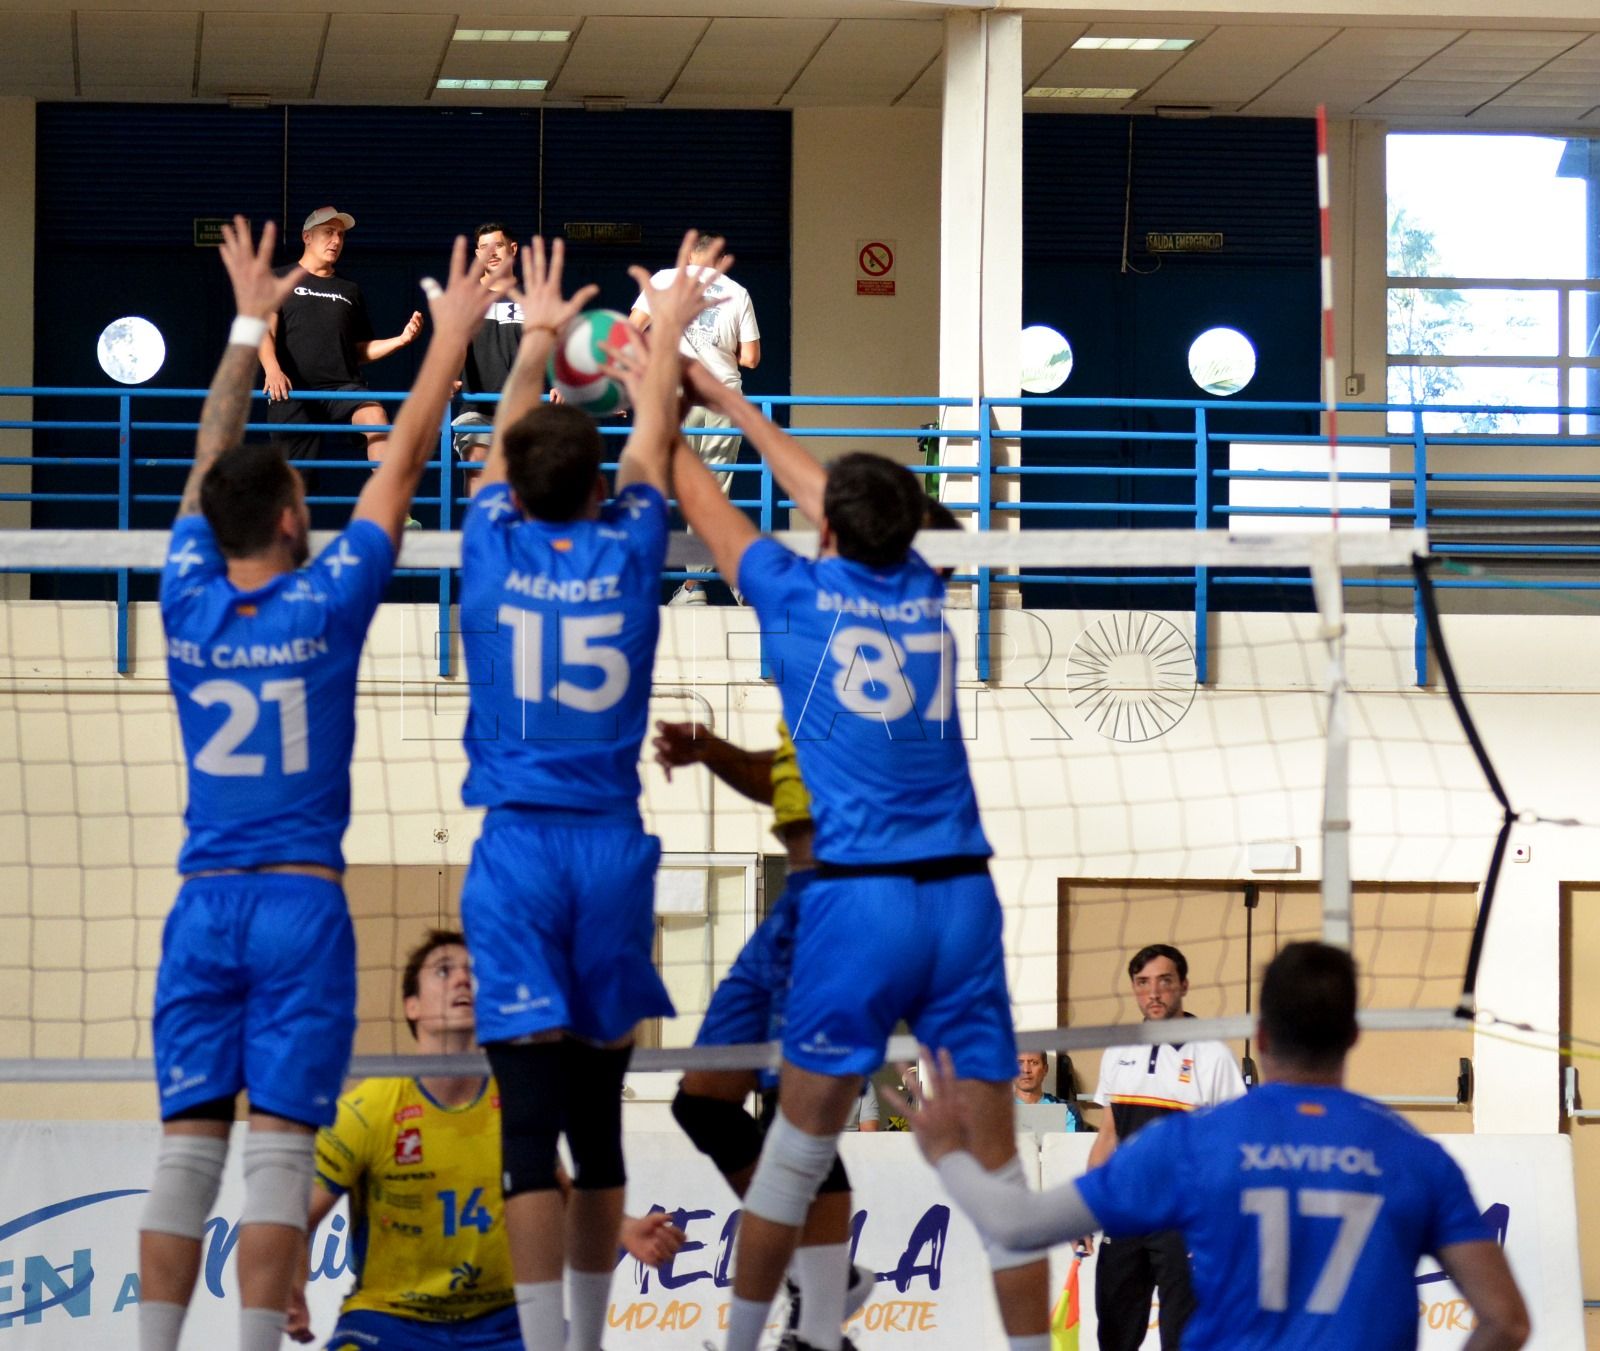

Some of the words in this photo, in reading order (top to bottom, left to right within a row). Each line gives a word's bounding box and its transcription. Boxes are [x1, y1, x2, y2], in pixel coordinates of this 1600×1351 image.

[1148, 235, 1174, 249] SALIDA
[1175, 235, 1221, 249] EMERGENCIA
[504, 569, 622, 604] MÉNDEZ
[211, 637, 329, 669] CARMEN
[498, 604, 631, 713] 15
[830, 625, 956, 723] 87
[189, 677, 309, 777] 21
[1240, 1143, 1383, 1177] XAVIFOL
[436, 1187, 493, 1238] 14
[1240, 1187, 1385, 1314] 17
[607, 1300, 702, 1331] UDAD
